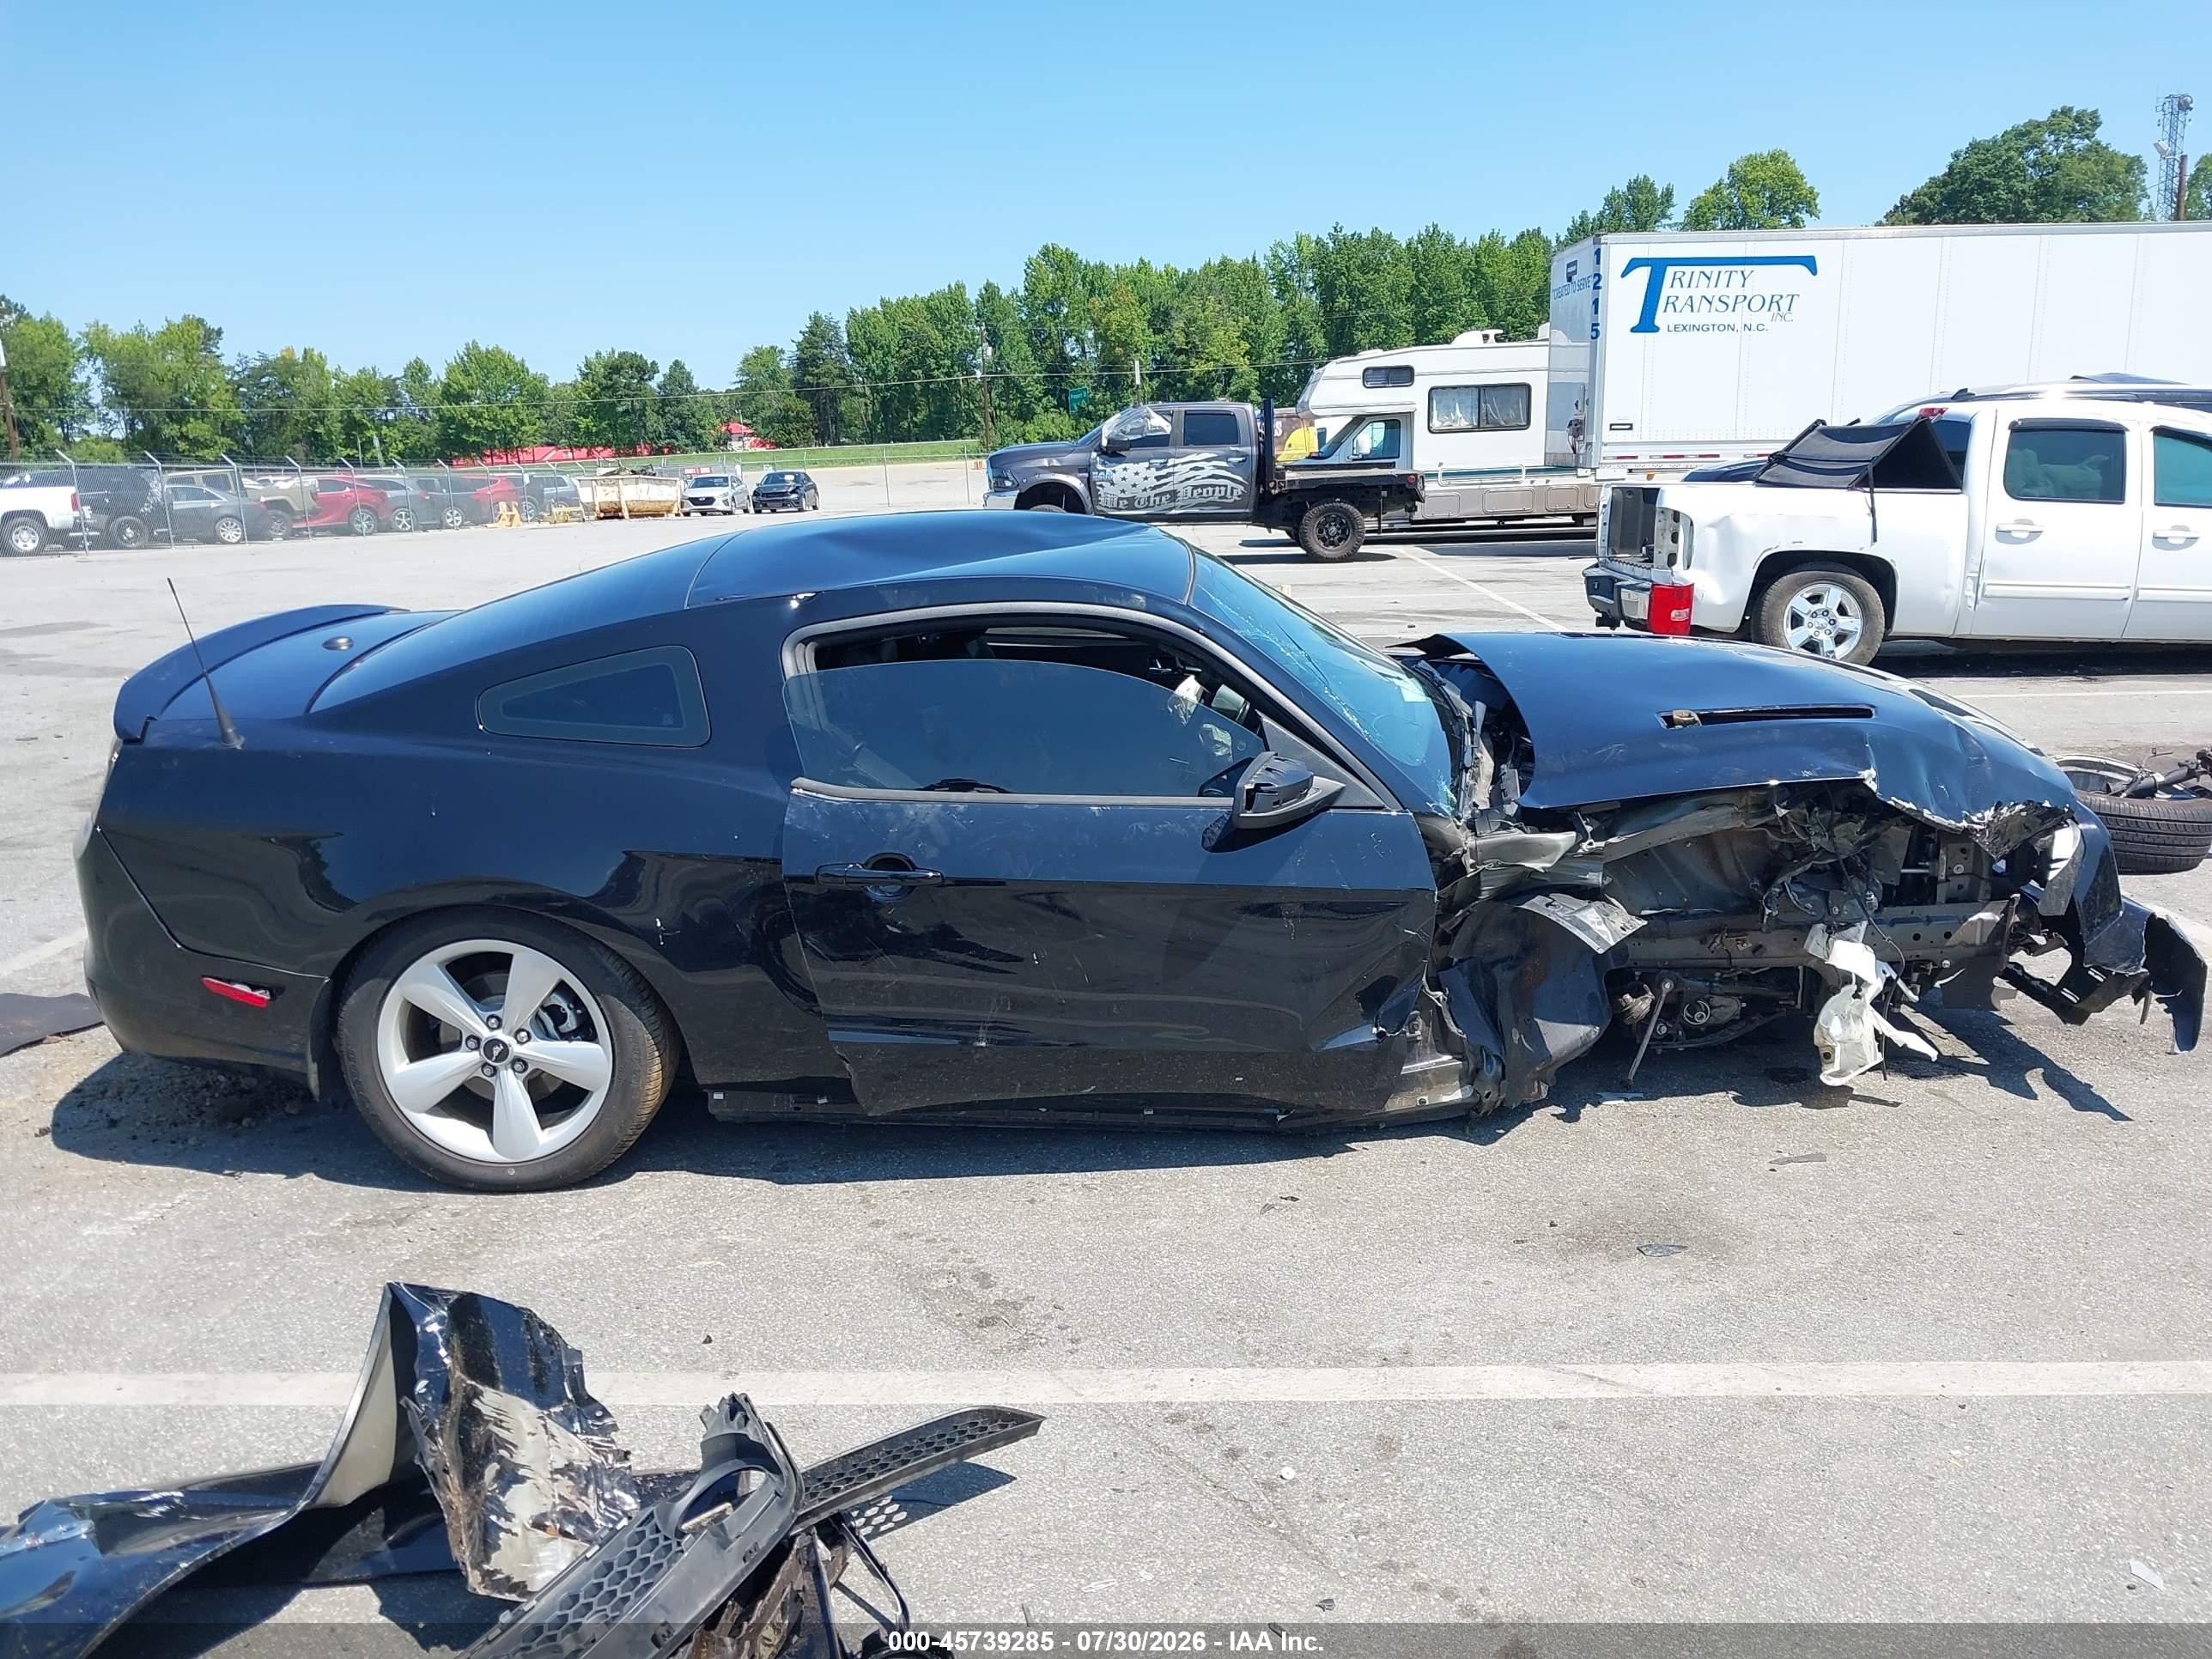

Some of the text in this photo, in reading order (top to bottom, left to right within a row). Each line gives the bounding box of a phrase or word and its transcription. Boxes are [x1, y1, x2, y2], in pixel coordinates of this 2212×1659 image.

[1771, 312, 1794, 322] INC.
[1667, 323, 1769, 333] LEXINGTON, N.C.
[1134, 492, 1171, 508] The
[1176, 483, 1243, 502] People
